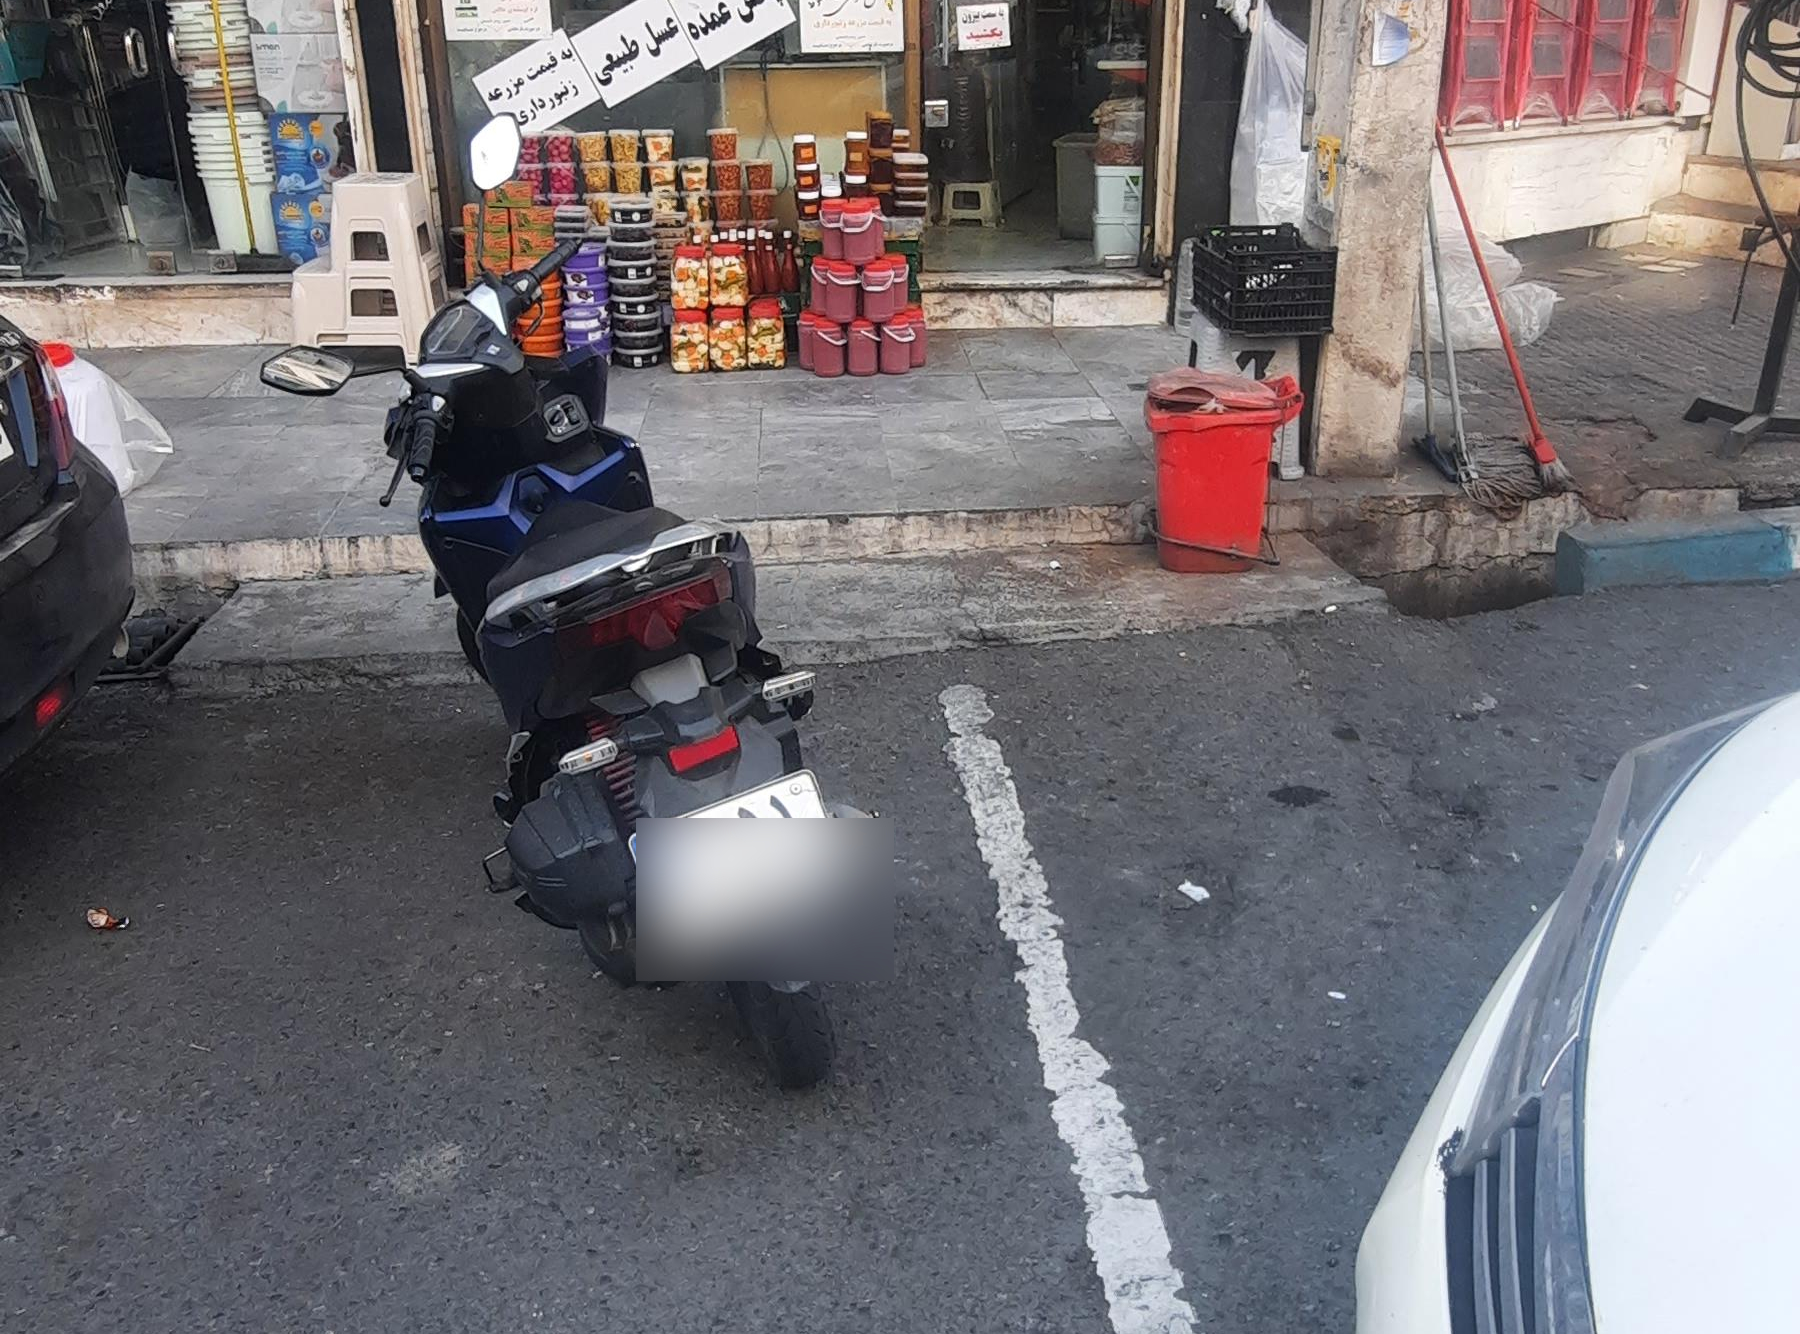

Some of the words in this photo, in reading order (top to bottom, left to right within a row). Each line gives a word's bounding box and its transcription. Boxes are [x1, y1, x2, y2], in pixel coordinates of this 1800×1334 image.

[646, 17, 680, 57] عسل
[687, 1, 732, 40] عمده
[526, 51, 558, 80] قیمت
[561, 48, 576, 62] به
[594, 35, 640, 86] طبیعی
[488, 77, 525, 102] مزرعه
